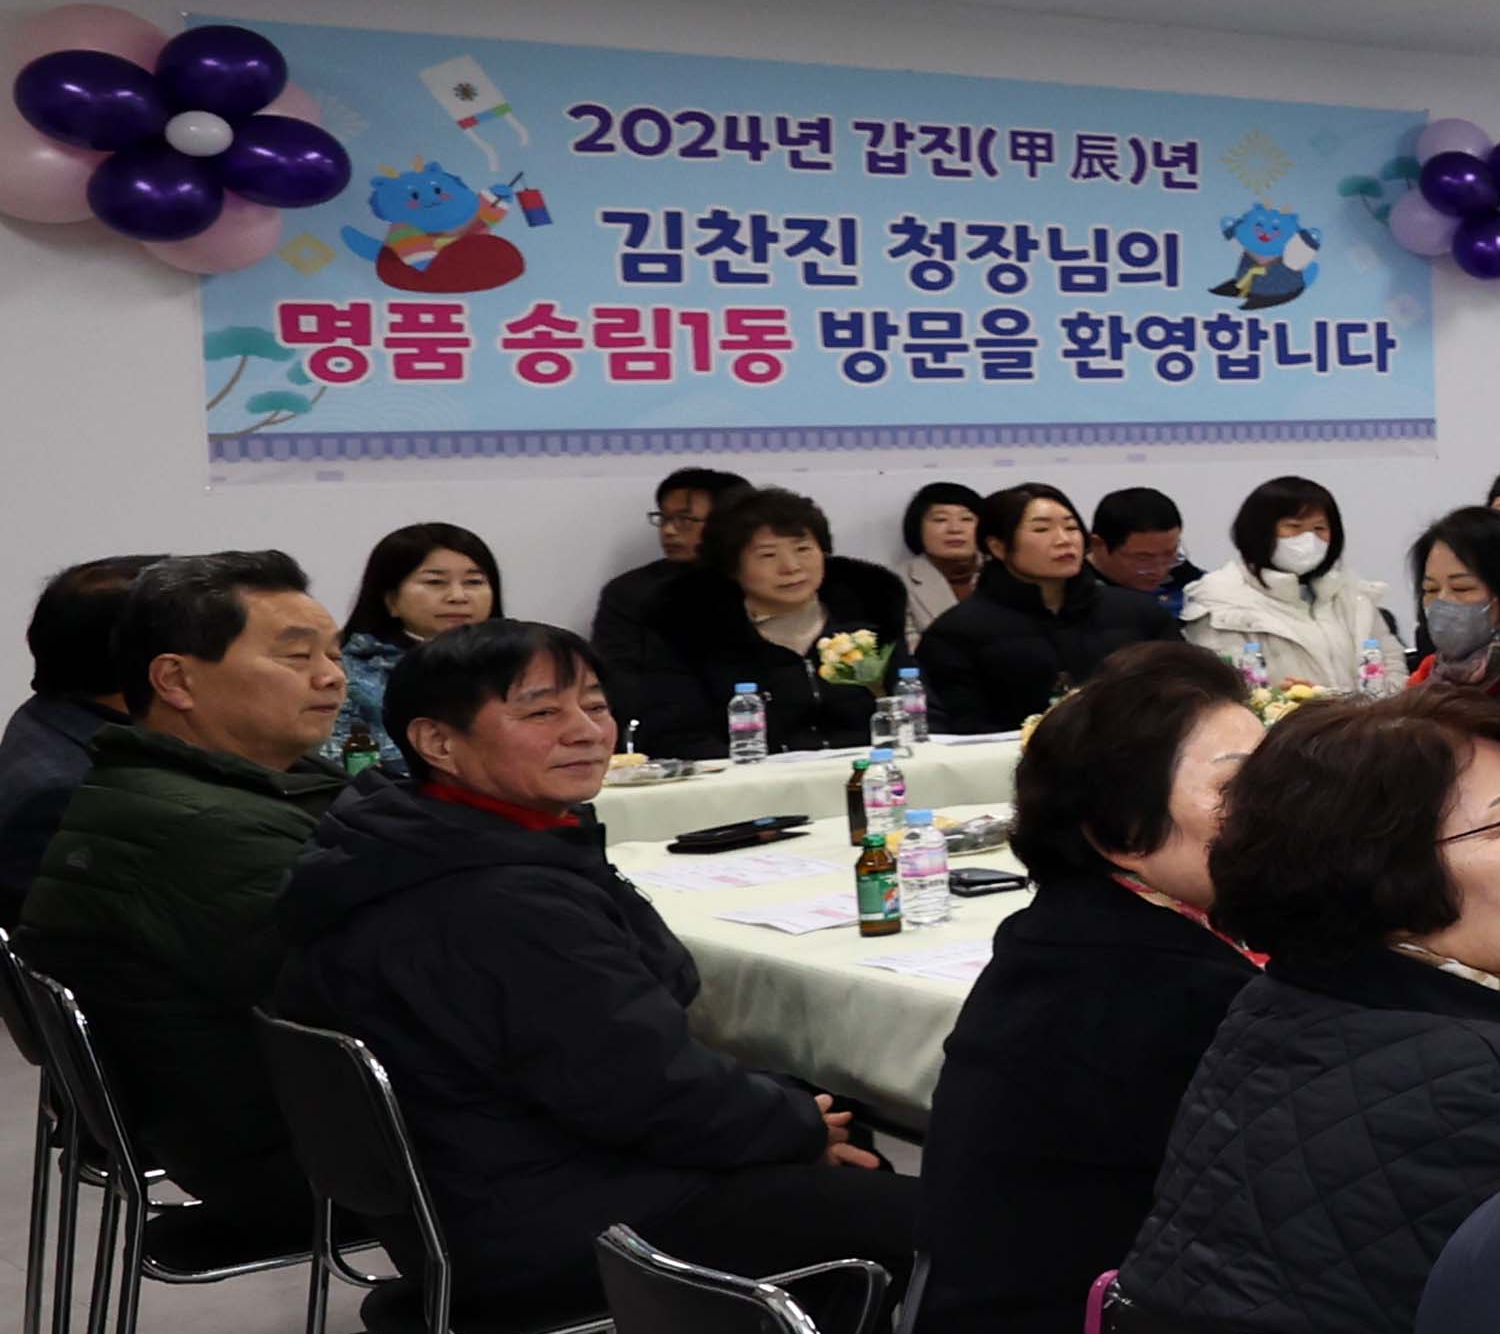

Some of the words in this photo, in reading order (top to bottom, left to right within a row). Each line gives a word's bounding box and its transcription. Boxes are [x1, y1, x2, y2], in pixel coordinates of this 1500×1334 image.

[566, 103, 833, 170] 2024년
[600, 208, 858, 286] 김찬진
[888, 215, 1179, 295] 청장님의
[278, 301, 471, 384] 명품
[501, 303, 793, 384] 송림1동
[818, 307, 1039, 384] 방문을
[1060, 311, 1397, 382] 환영합니다
